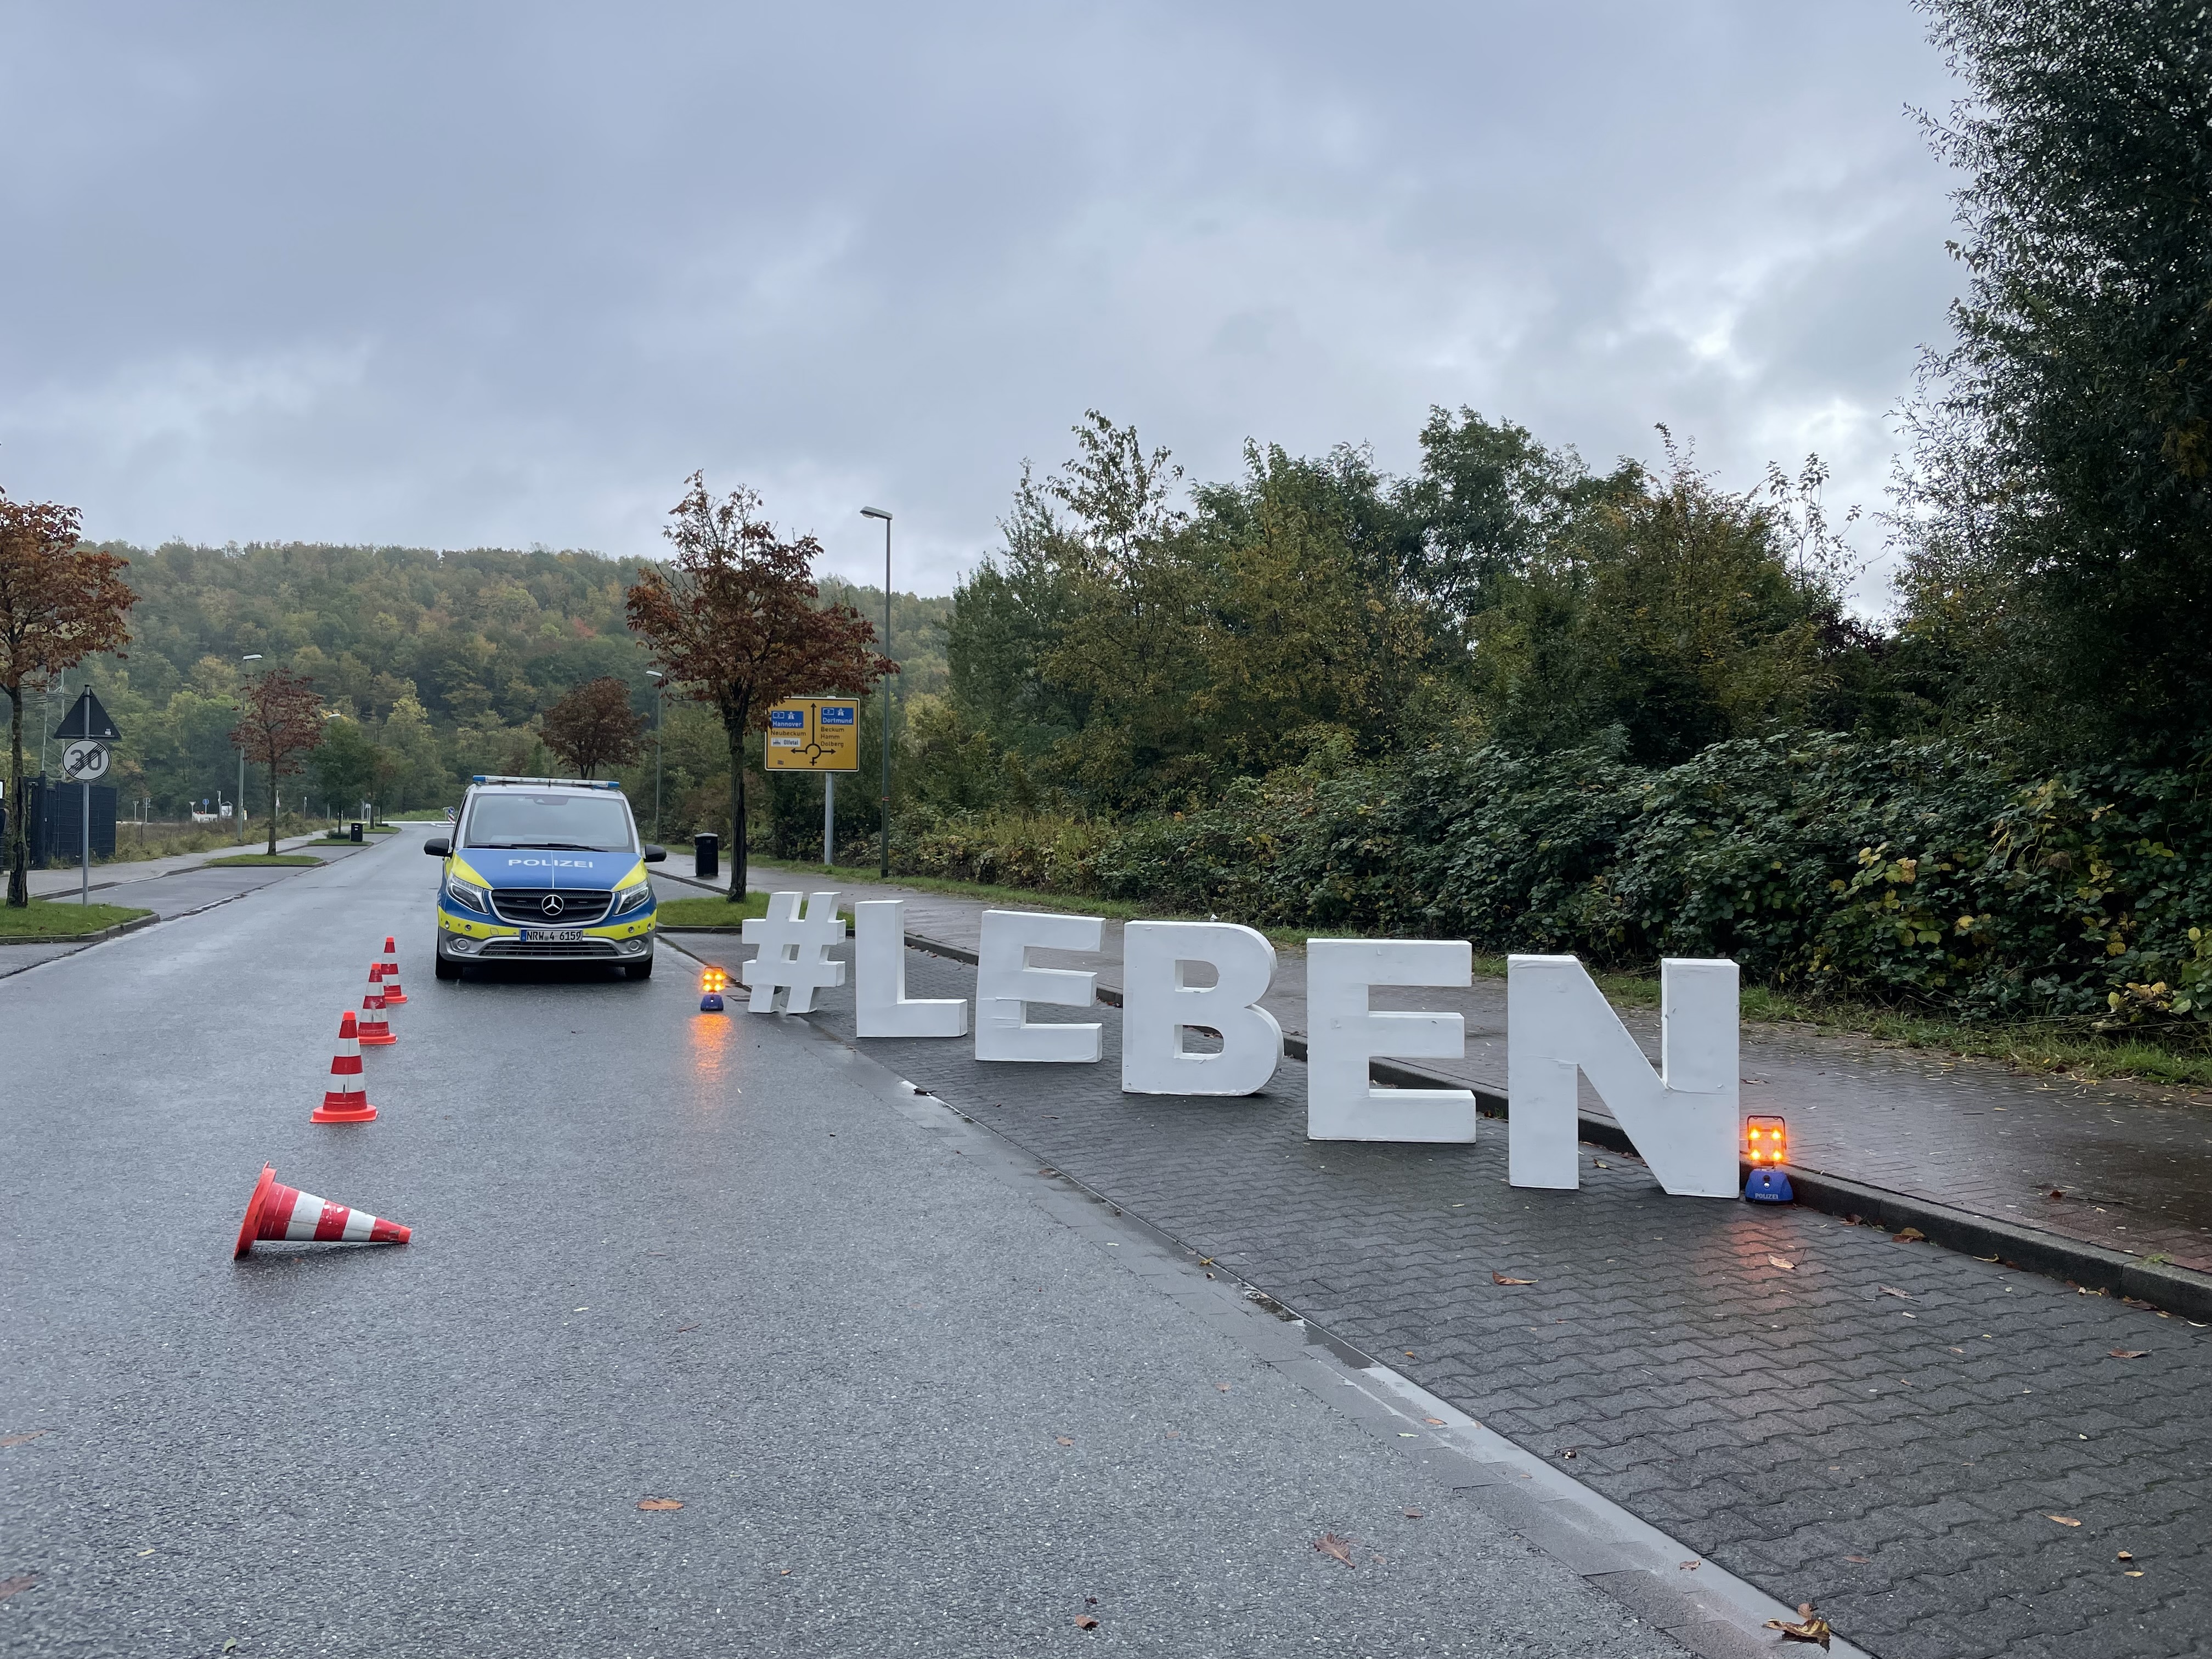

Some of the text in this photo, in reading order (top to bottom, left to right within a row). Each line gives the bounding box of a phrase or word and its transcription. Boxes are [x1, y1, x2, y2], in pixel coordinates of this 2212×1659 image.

[70, 749, 101, 771] 30
[509, 859, 593, 868] POLIZEI
[527, 931, 544, 940] NRW
[742, 891, 1740, 1199] #LEBEN
